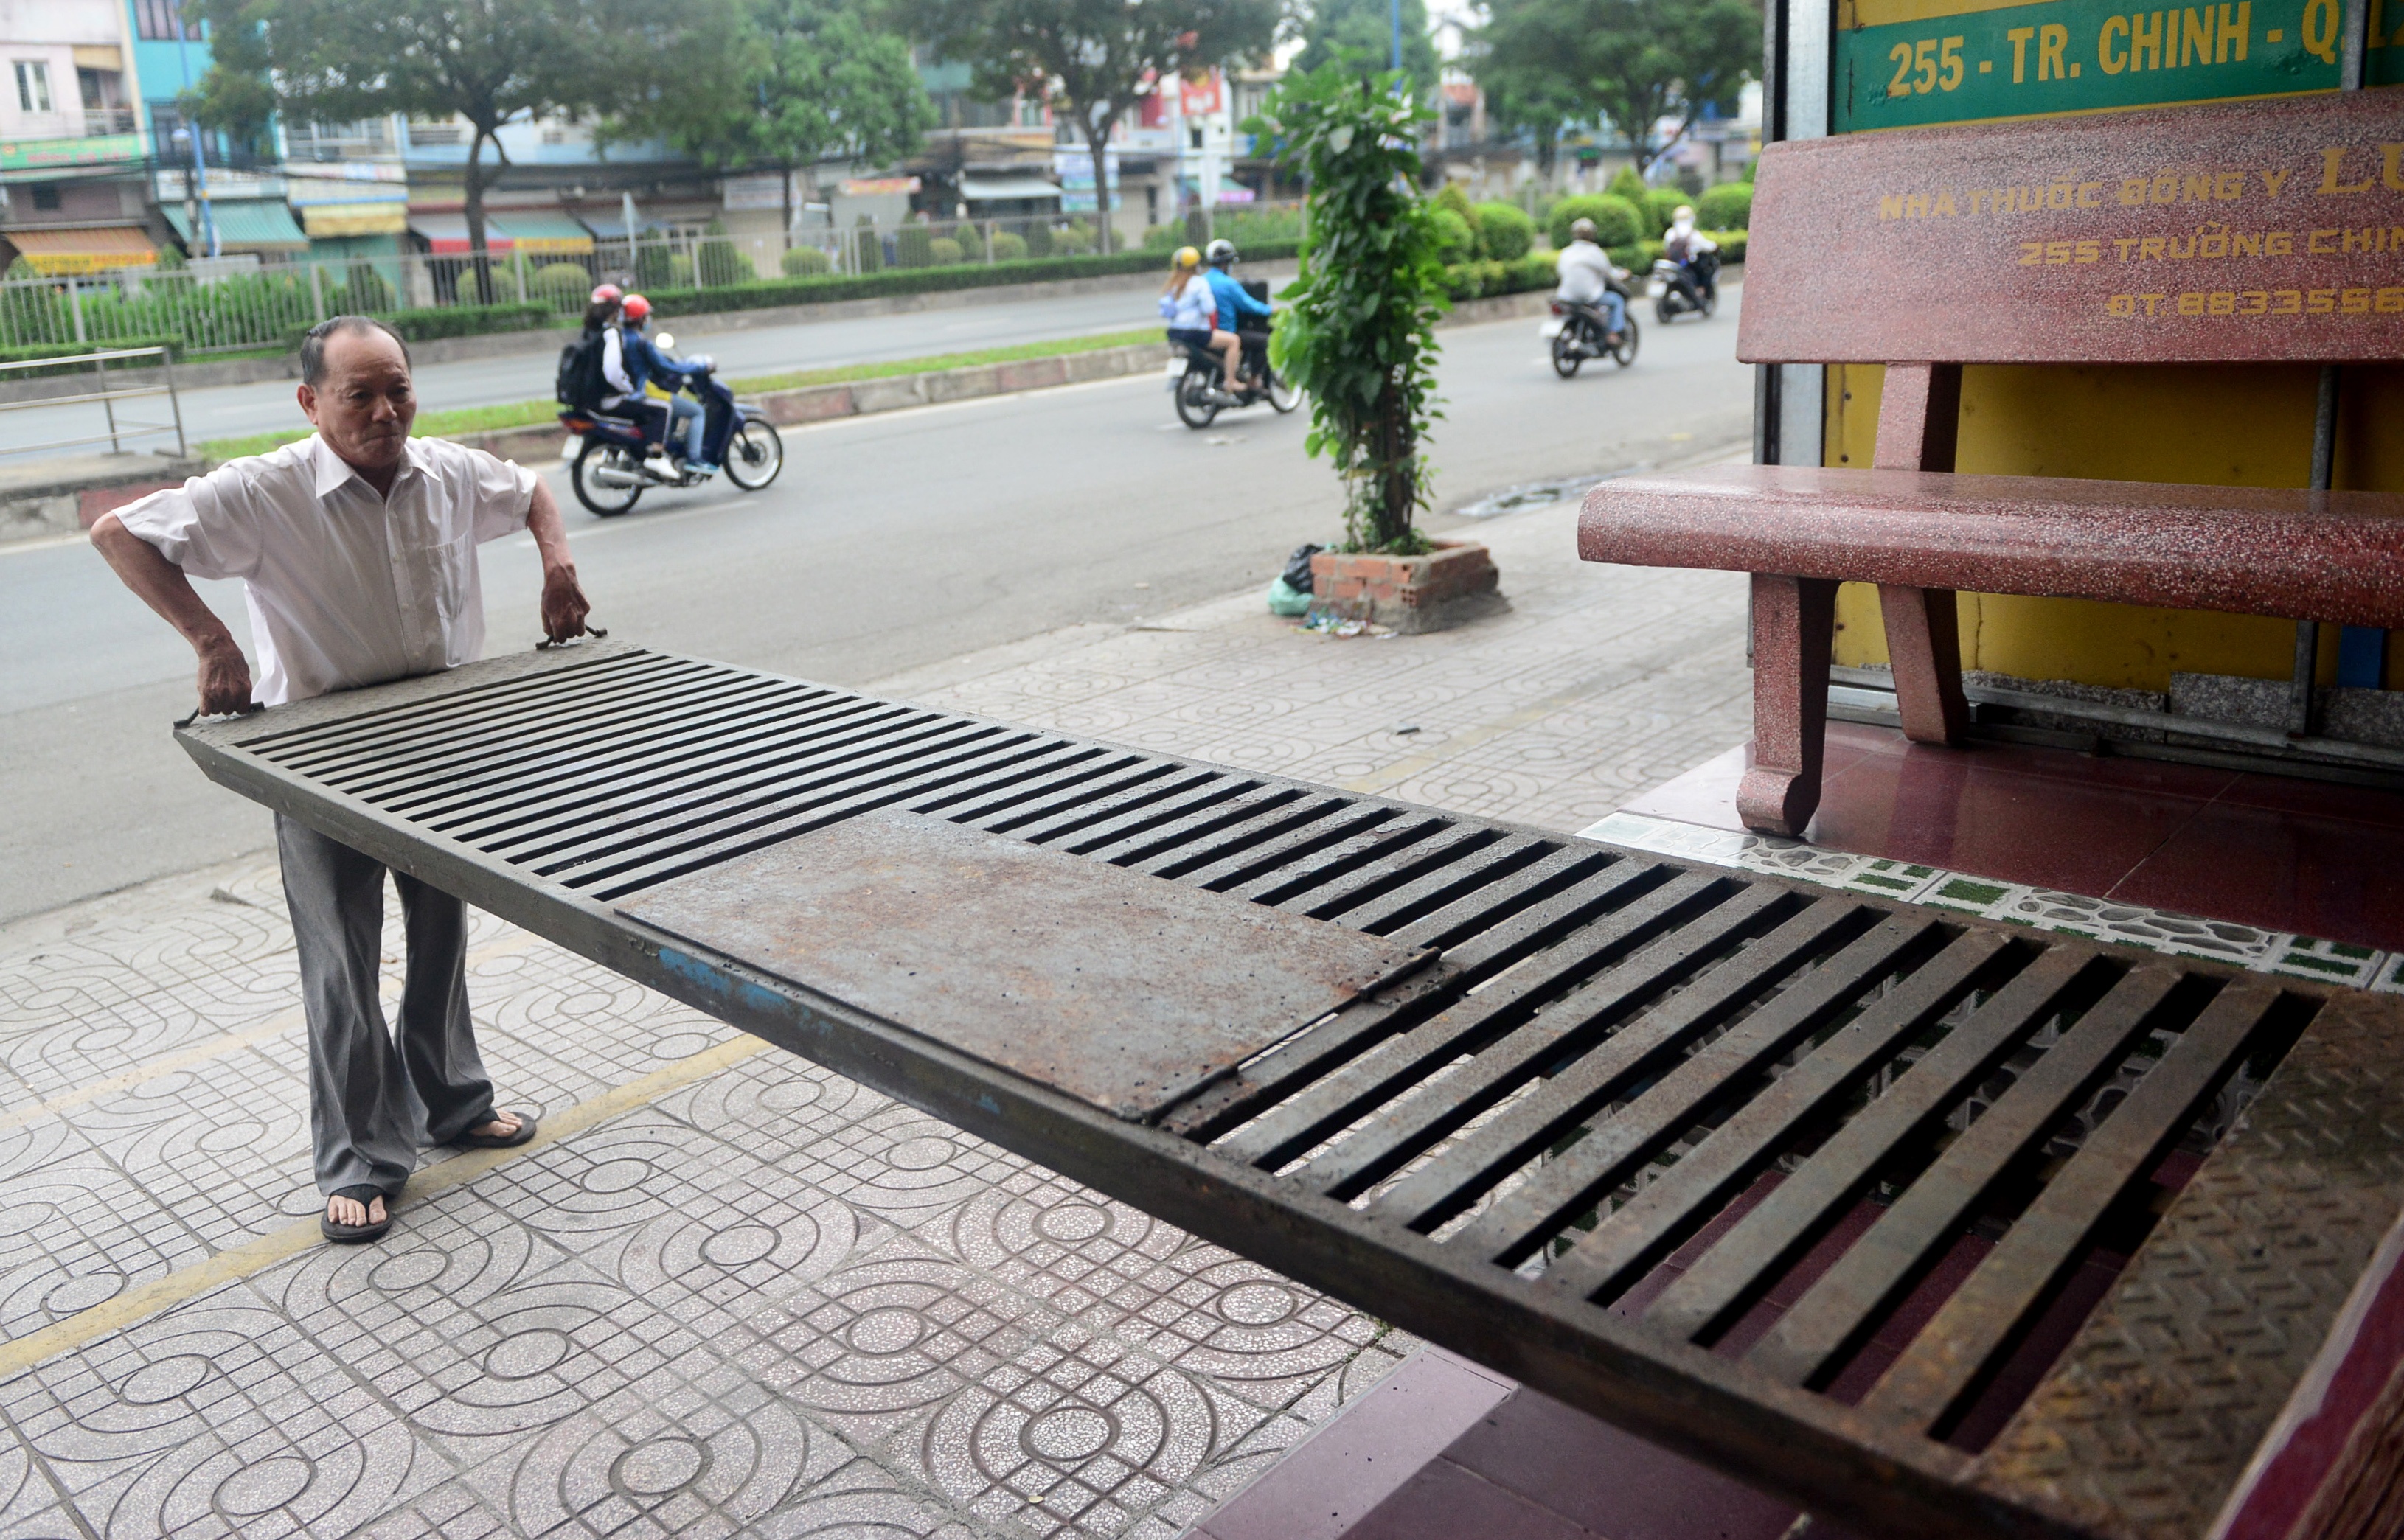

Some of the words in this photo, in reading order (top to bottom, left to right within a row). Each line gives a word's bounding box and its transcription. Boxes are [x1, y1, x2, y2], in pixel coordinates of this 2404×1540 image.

[1887, 35, 1964, 98] 255
[2007, 24, 2081, 84] TR.
[2098, 1, 2251, 74] CHINH
[1966, 167, 2102, 215] THUỐC
[2116, 168, 2245, 206] ĐÔNG
[2261, 169, 2290, 198] Y
[2018, 241, 2101, 266] 255
[2113, 220, 2294, 262] TRƯỜNG
